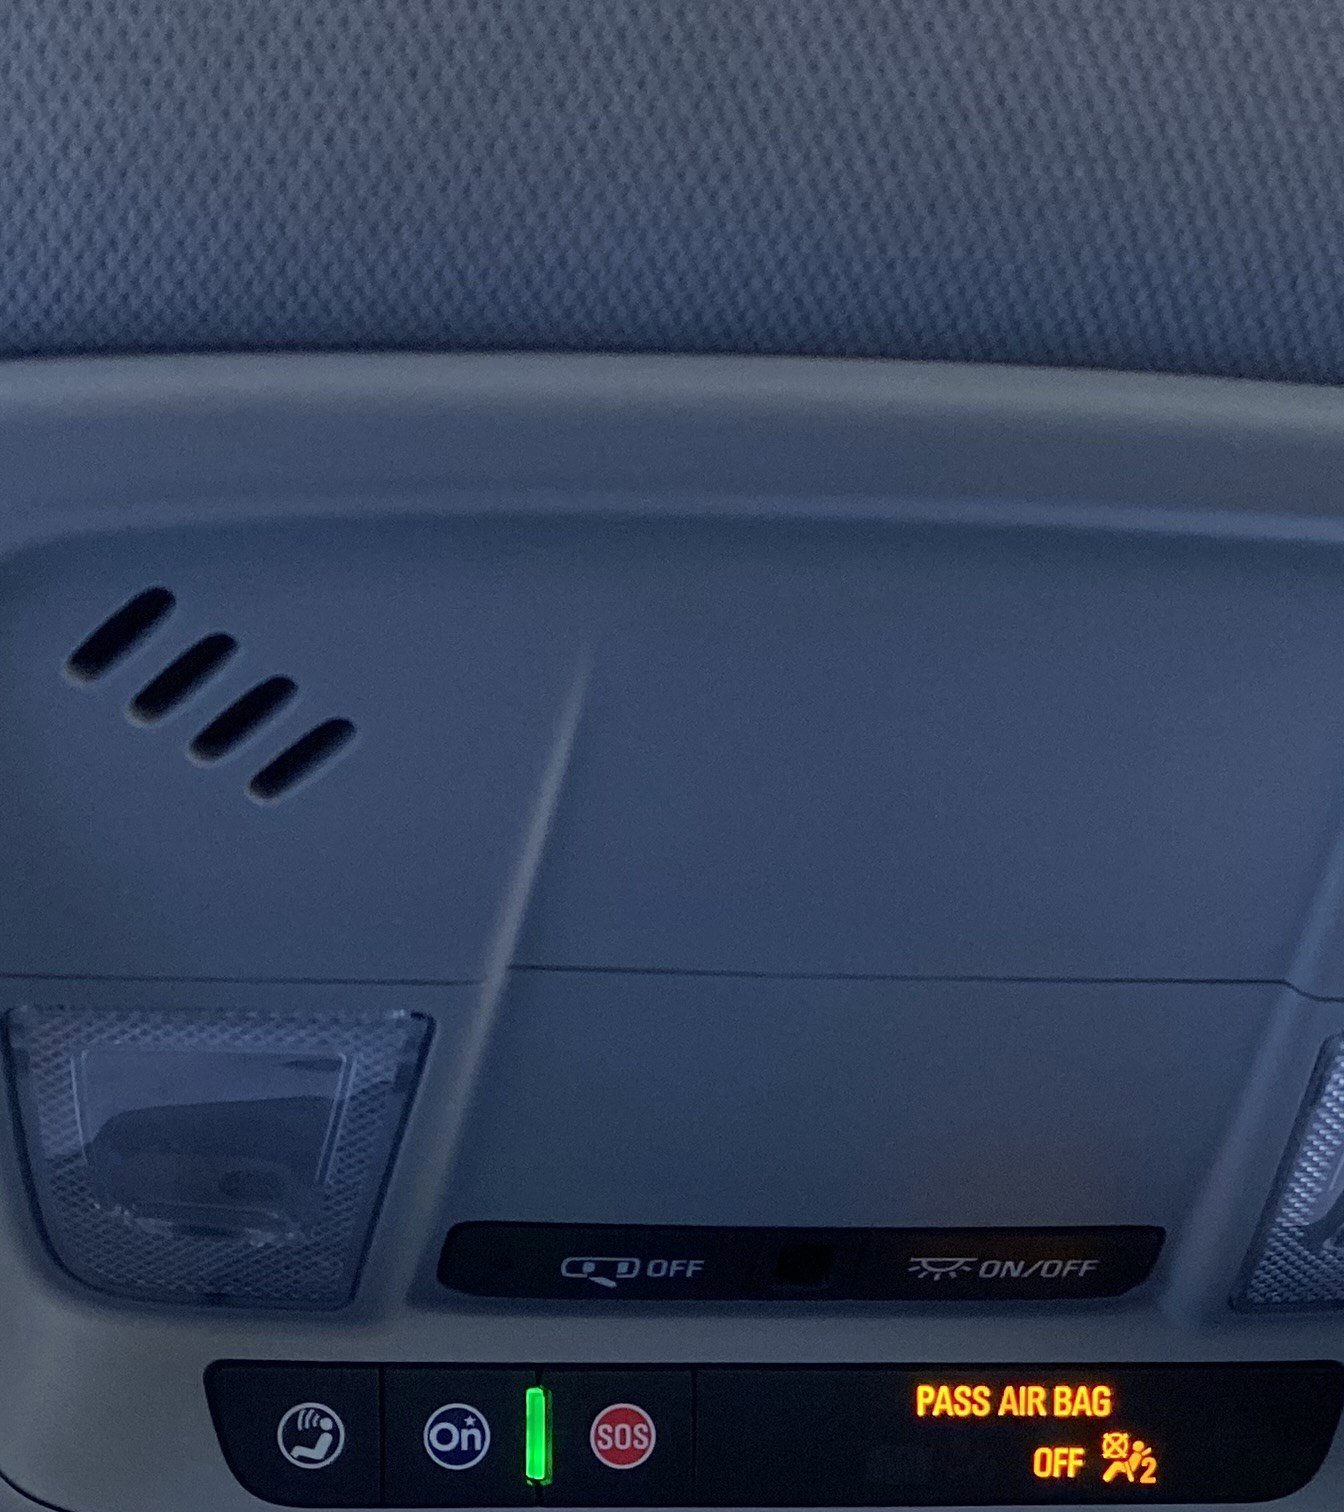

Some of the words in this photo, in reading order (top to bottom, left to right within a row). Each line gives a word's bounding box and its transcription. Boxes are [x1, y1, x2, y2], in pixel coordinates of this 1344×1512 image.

[647, 1258, 705, 1278] OFF
[977, 1258, 1099, 1279] ON/OFF
[916, 1385, 991, 1417] PASS
[997, 1385, 1047, 1417] AIR
[1053, 1385, 1112, 1417] BAG
[596, 1423, 650, 1450] SOS
[1033, 1447, 1085, 1478] OFF
